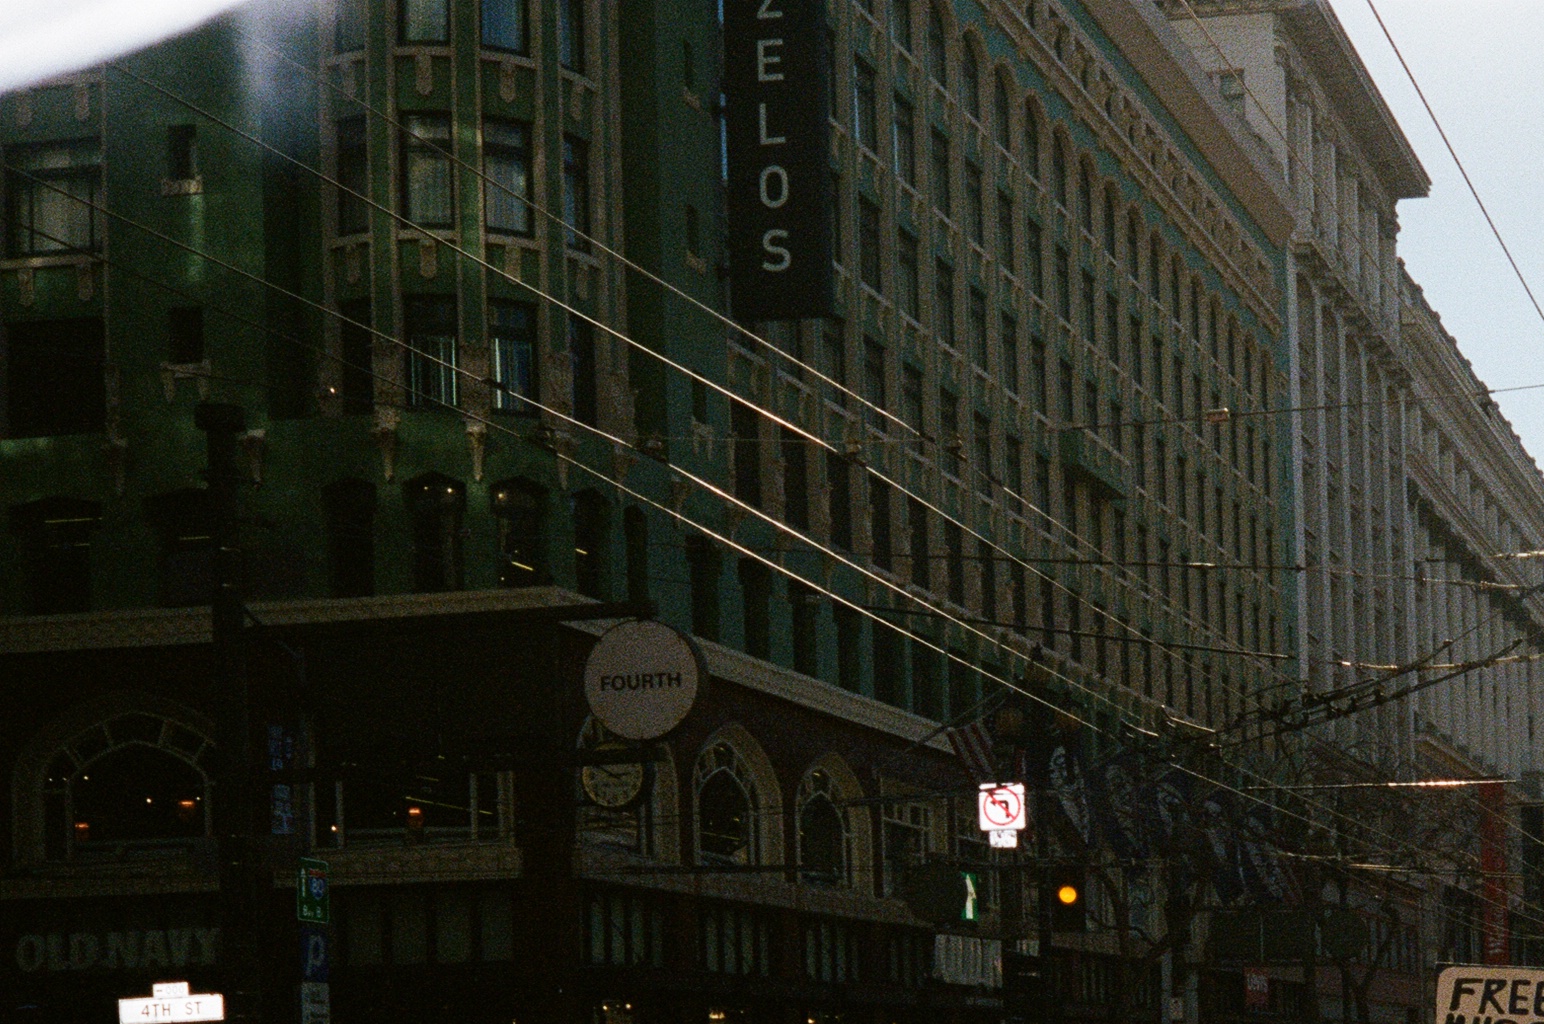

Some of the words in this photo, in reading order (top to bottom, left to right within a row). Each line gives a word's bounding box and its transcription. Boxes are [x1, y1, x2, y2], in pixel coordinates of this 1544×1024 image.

[600, 672, 682, 691] FOURTH
[17, 933, 99, 972] OLD
[106, 927, 219, 969] NAVY
[141, 1003, 171, 1018] 4TH
[185, 1001, 202, 1016] ST
